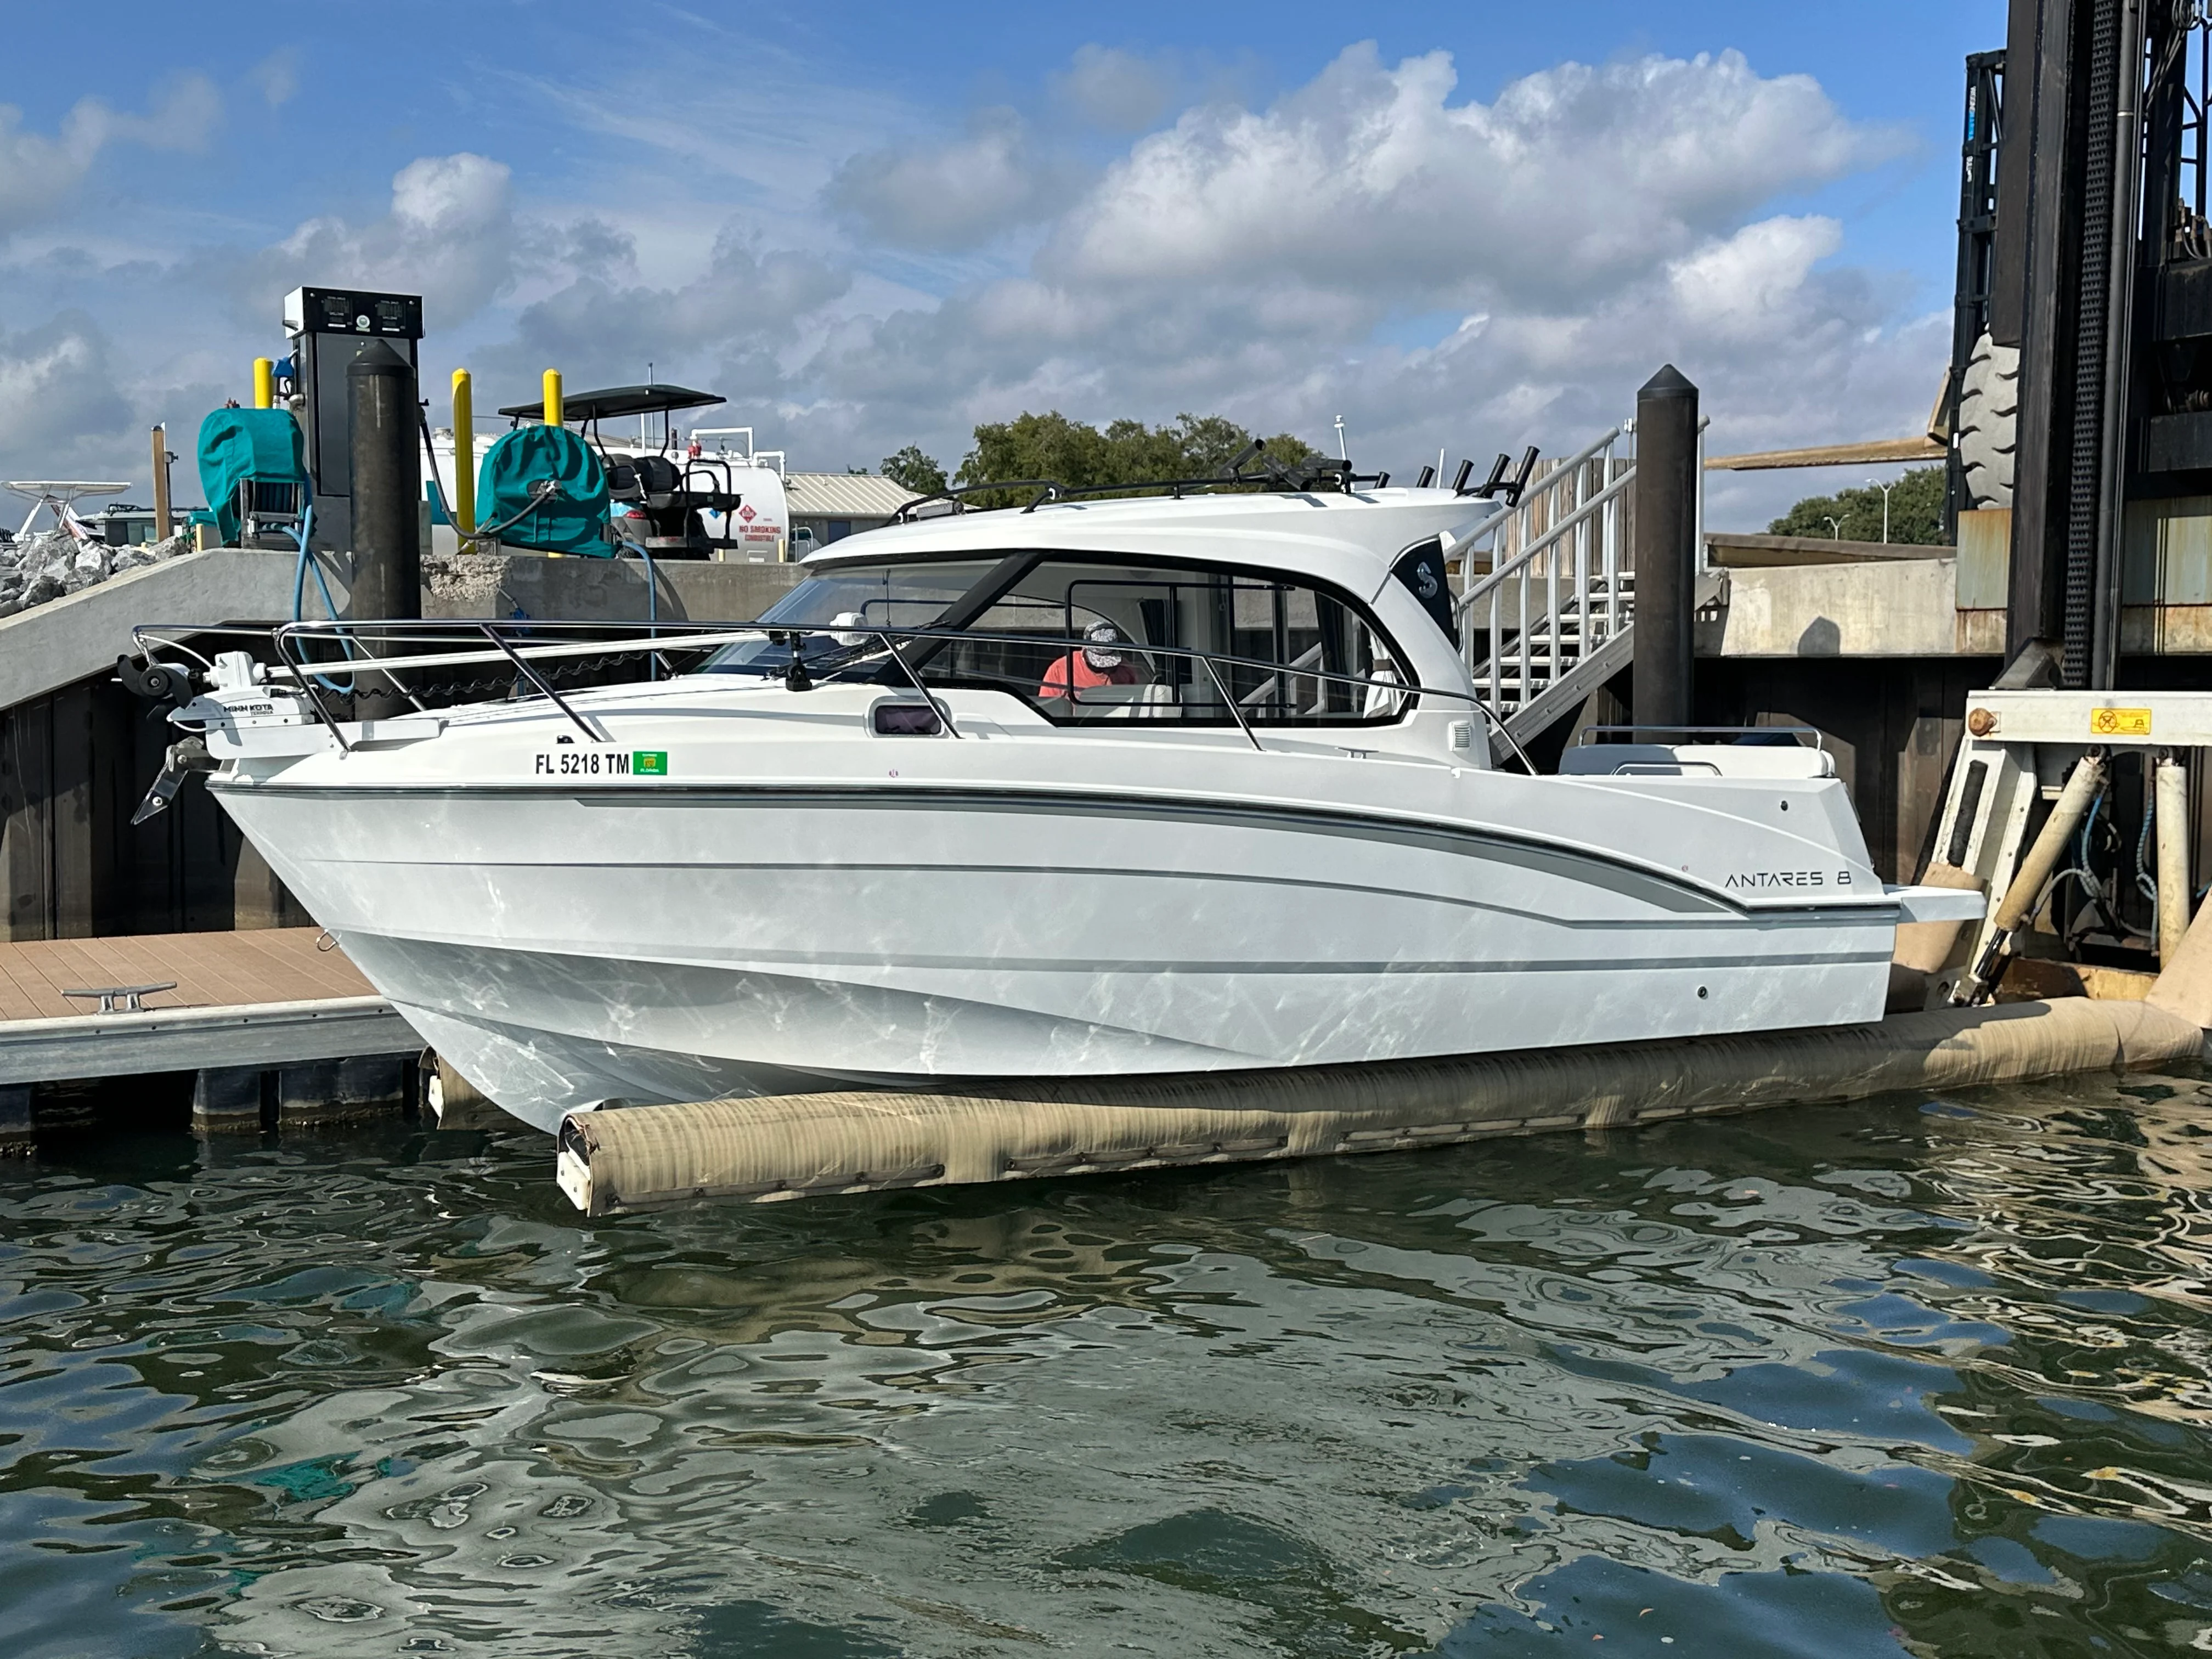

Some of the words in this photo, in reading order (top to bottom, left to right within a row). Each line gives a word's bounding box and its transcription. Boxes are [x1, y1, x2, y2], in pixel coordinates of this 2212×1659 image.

[751, 525, 781, 534] SMOKING
[535, 754, 555, 774] FL
[560, 753, 600, 774] 5218
[605, 754, 629, 774] TM
[1725, 871, 1824, 888] ANTARES
[1837, 871, 1852, 885] 8
